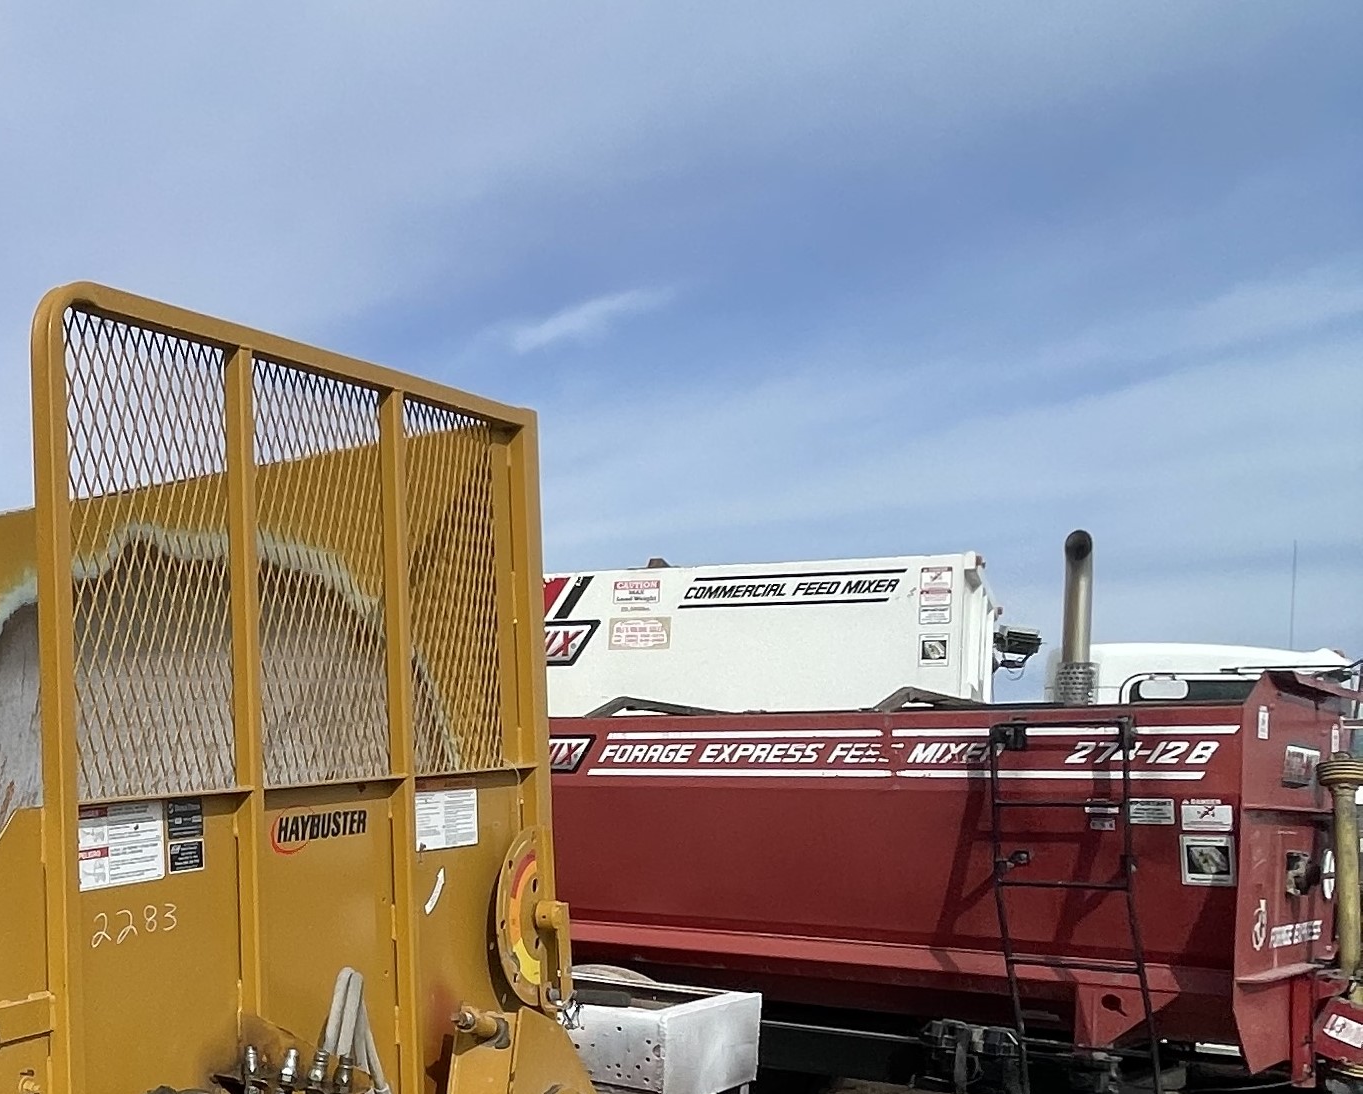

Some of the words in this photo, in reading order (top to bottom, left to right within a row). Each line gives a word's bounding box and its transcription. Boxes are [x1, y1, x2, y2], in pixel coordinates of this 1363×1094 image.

[616, 581, 657, 589] CAUTION
[684, 583, 787, 599] COMMERCIAL
[792, 580, 843, 596] FEED
[841, 578, 900, 594] MIXER
[545, 630, 584, 656] IX
[597, 743, 696, 763] FORAGE
[698, 743, 825, 763] EXPRESS
[277, 809, 367, 844] HAYBUSTER
[90, 903, 178, 949] 2283
